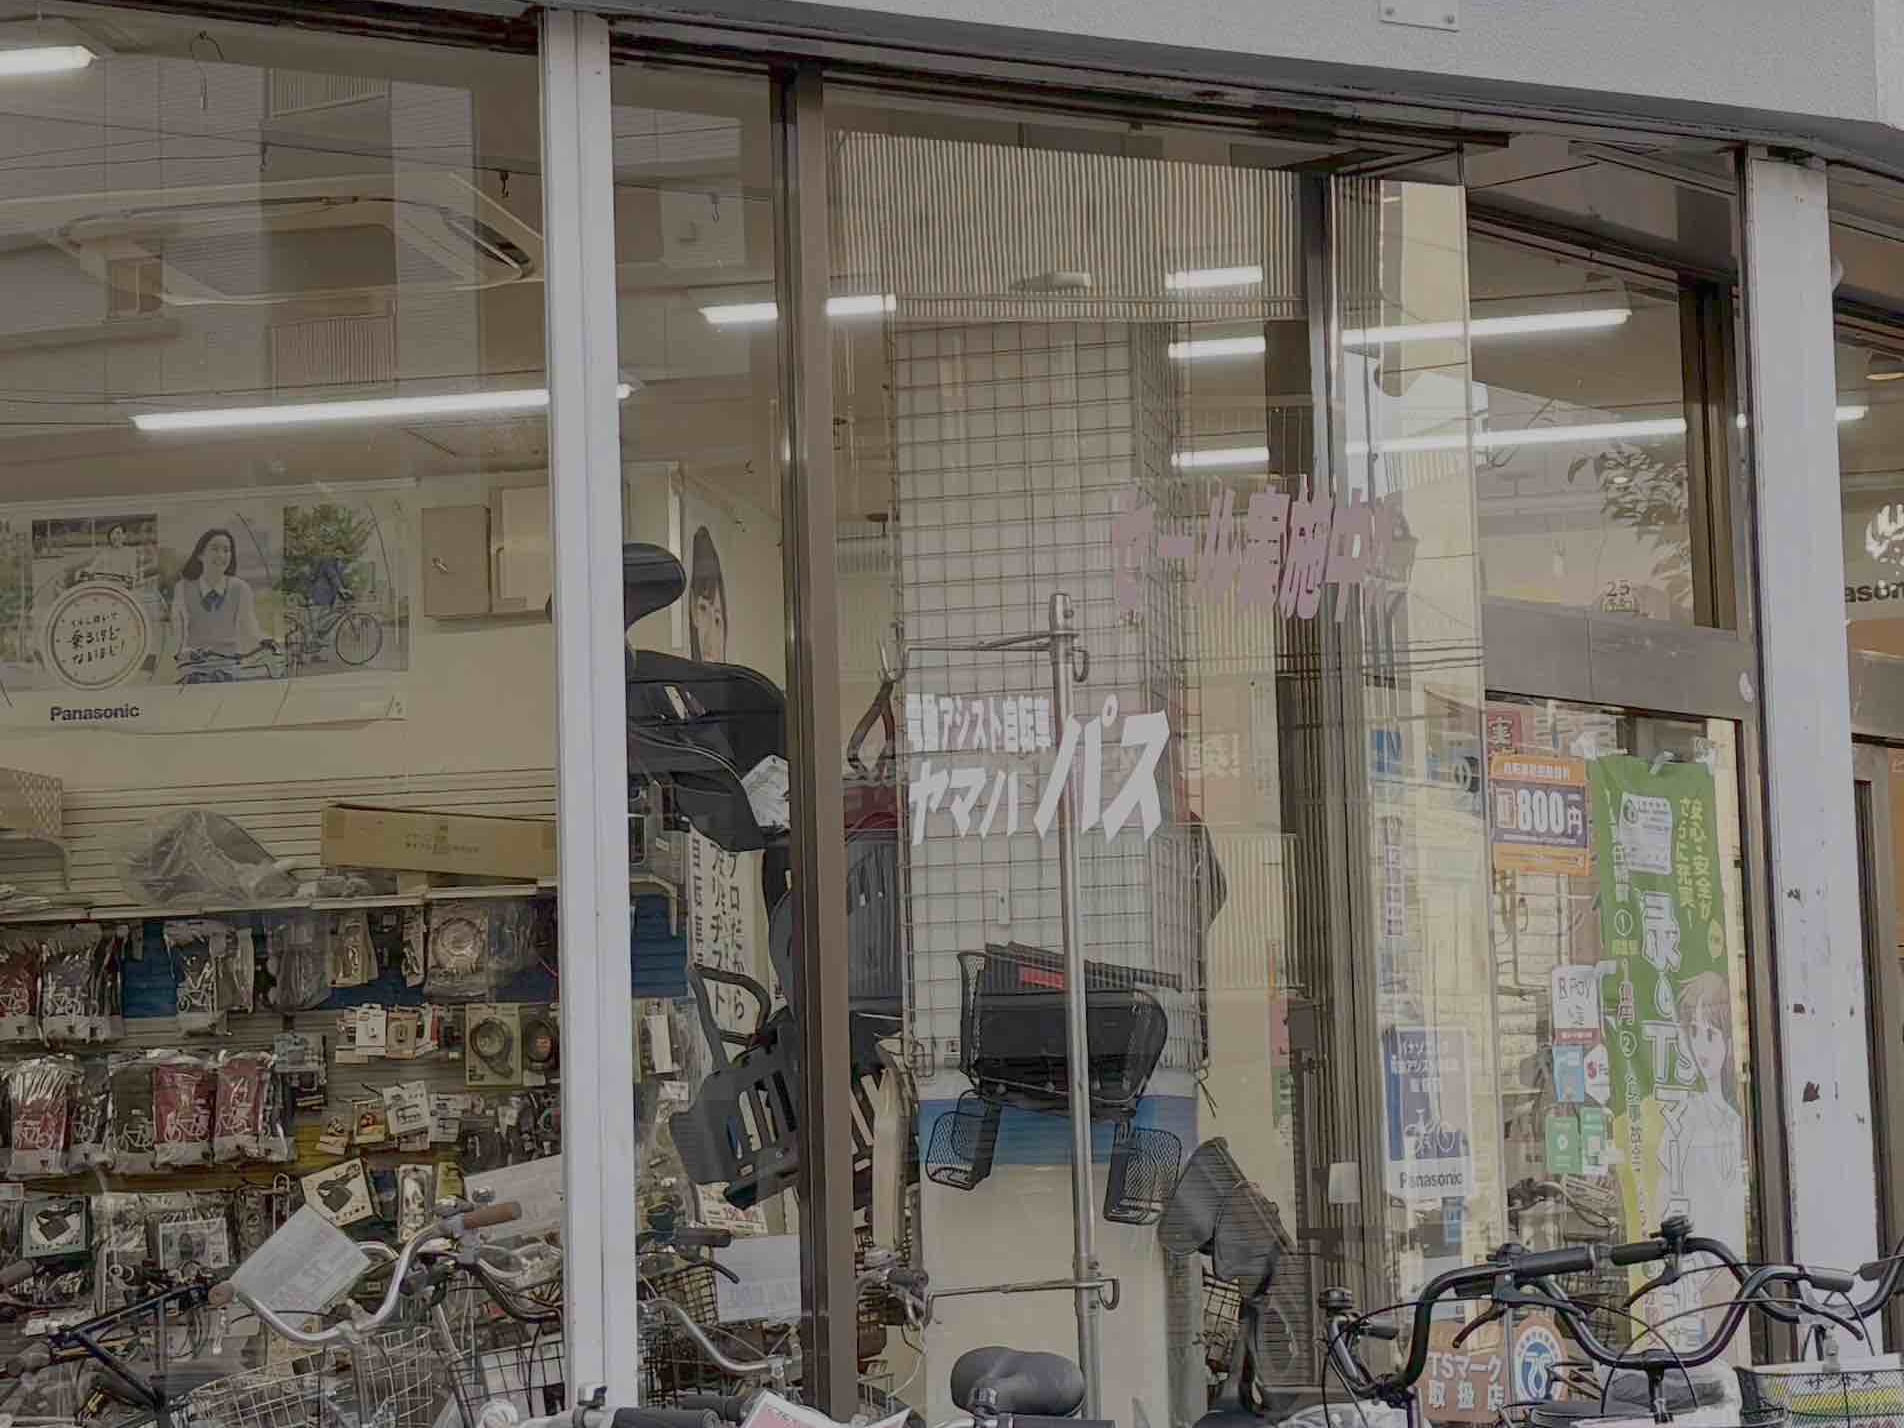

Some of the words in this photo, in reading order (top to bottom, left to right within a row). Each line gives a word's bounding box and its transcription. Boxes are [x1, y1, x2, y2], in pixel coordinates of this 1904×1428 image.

[50, 703, 140, 721] Panasonic
[909, 760, 1018, 846] ヤマハ
[1033, 692, 1171, 844] パス
